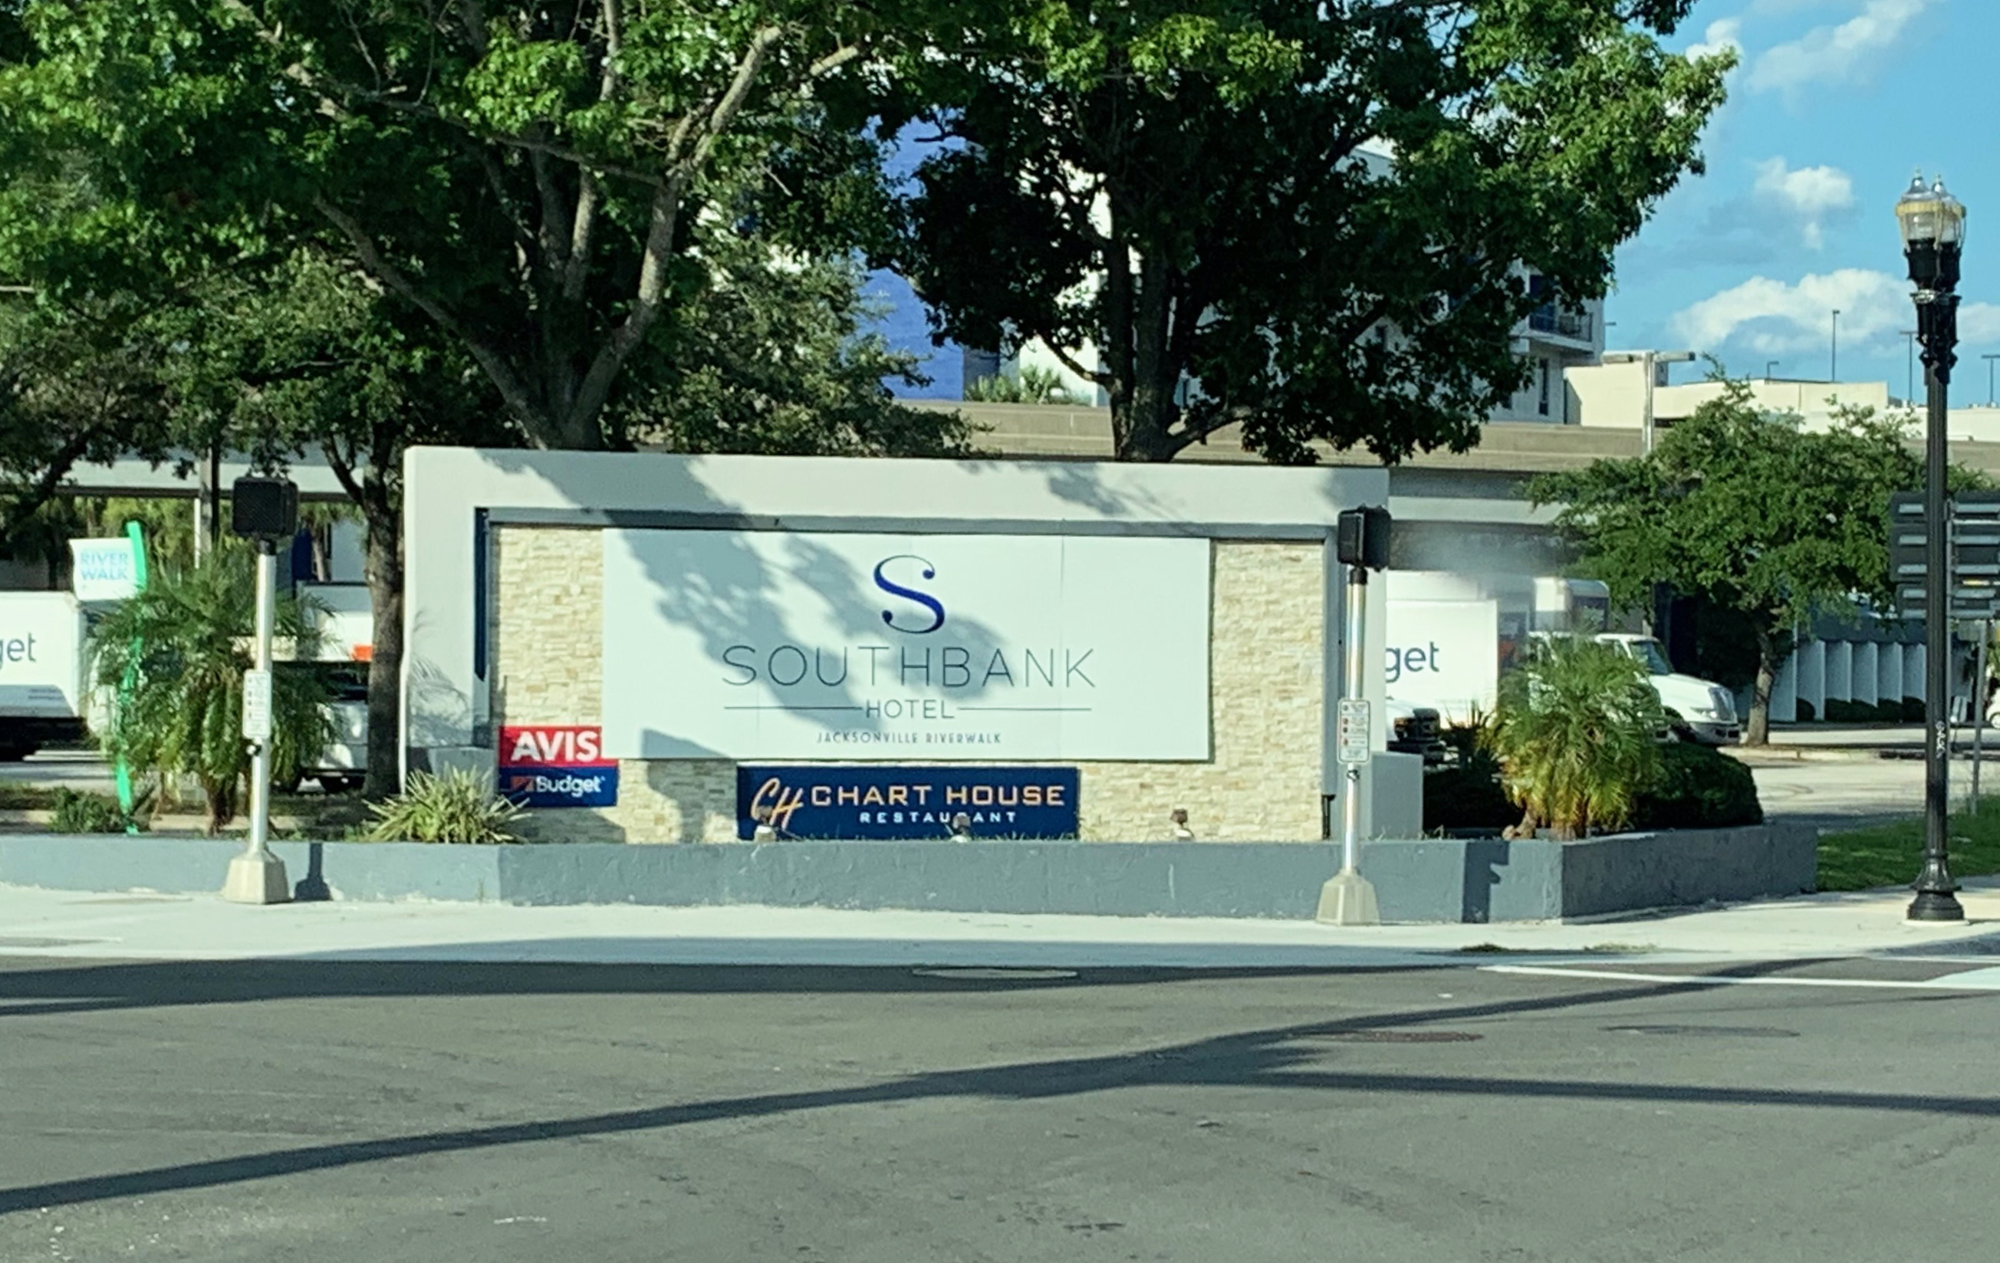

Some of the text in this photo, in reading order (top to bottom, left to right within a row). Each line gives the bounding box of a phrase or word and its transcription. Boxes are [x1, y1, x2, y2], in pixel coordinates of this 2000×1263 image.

[80, 551, 128, 565] RIVER
[80, 567, 129, 581] WALK
[873, 554, 946, 634] S
[0, 632, 37, 670] et
[722, 644, 1096, 688] SOUTHBANK
[865, 699, 955, 719] HOTEL
[510, 730, 599, 763] AVIS
[816, 731, 1002, 745] JACKSONVILLE RIVERWALK
[536, 774, 602, 798] Budget
[811, 784, 933, 807] CHART
[946, 784, 1066, 807] HOUSE
[859, 811, 1017, 824] RESTAUANT
